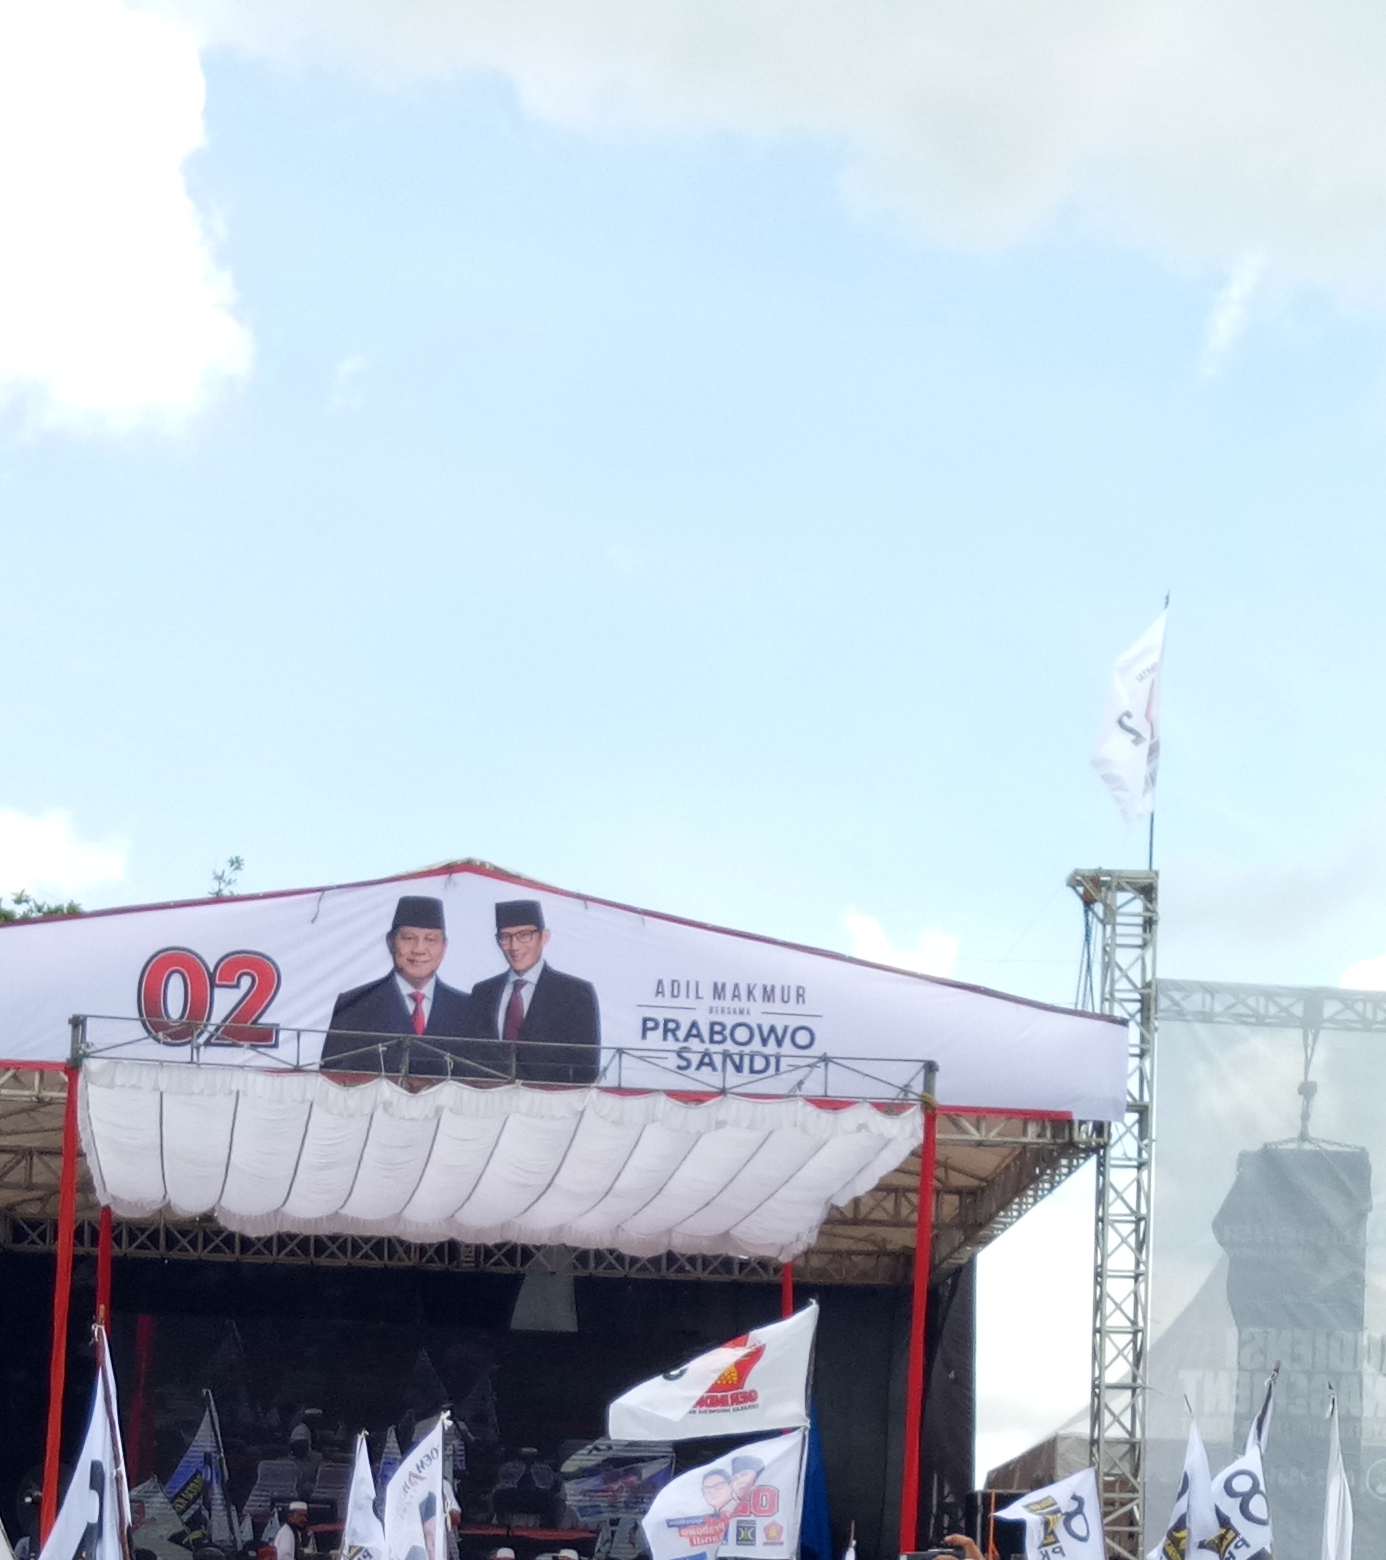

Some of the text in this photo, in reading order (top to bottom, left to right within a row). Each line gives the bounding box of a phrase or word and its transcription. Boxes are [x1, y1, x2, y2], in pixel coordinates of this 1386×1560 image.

[137, 946, 281, 1049] 02
[655, 979, 806, 1005] ADIL MAKMUR
[641, 1016, 816, 1050] PRABOWO
[676, 1047, 781, 1075] SANDI
